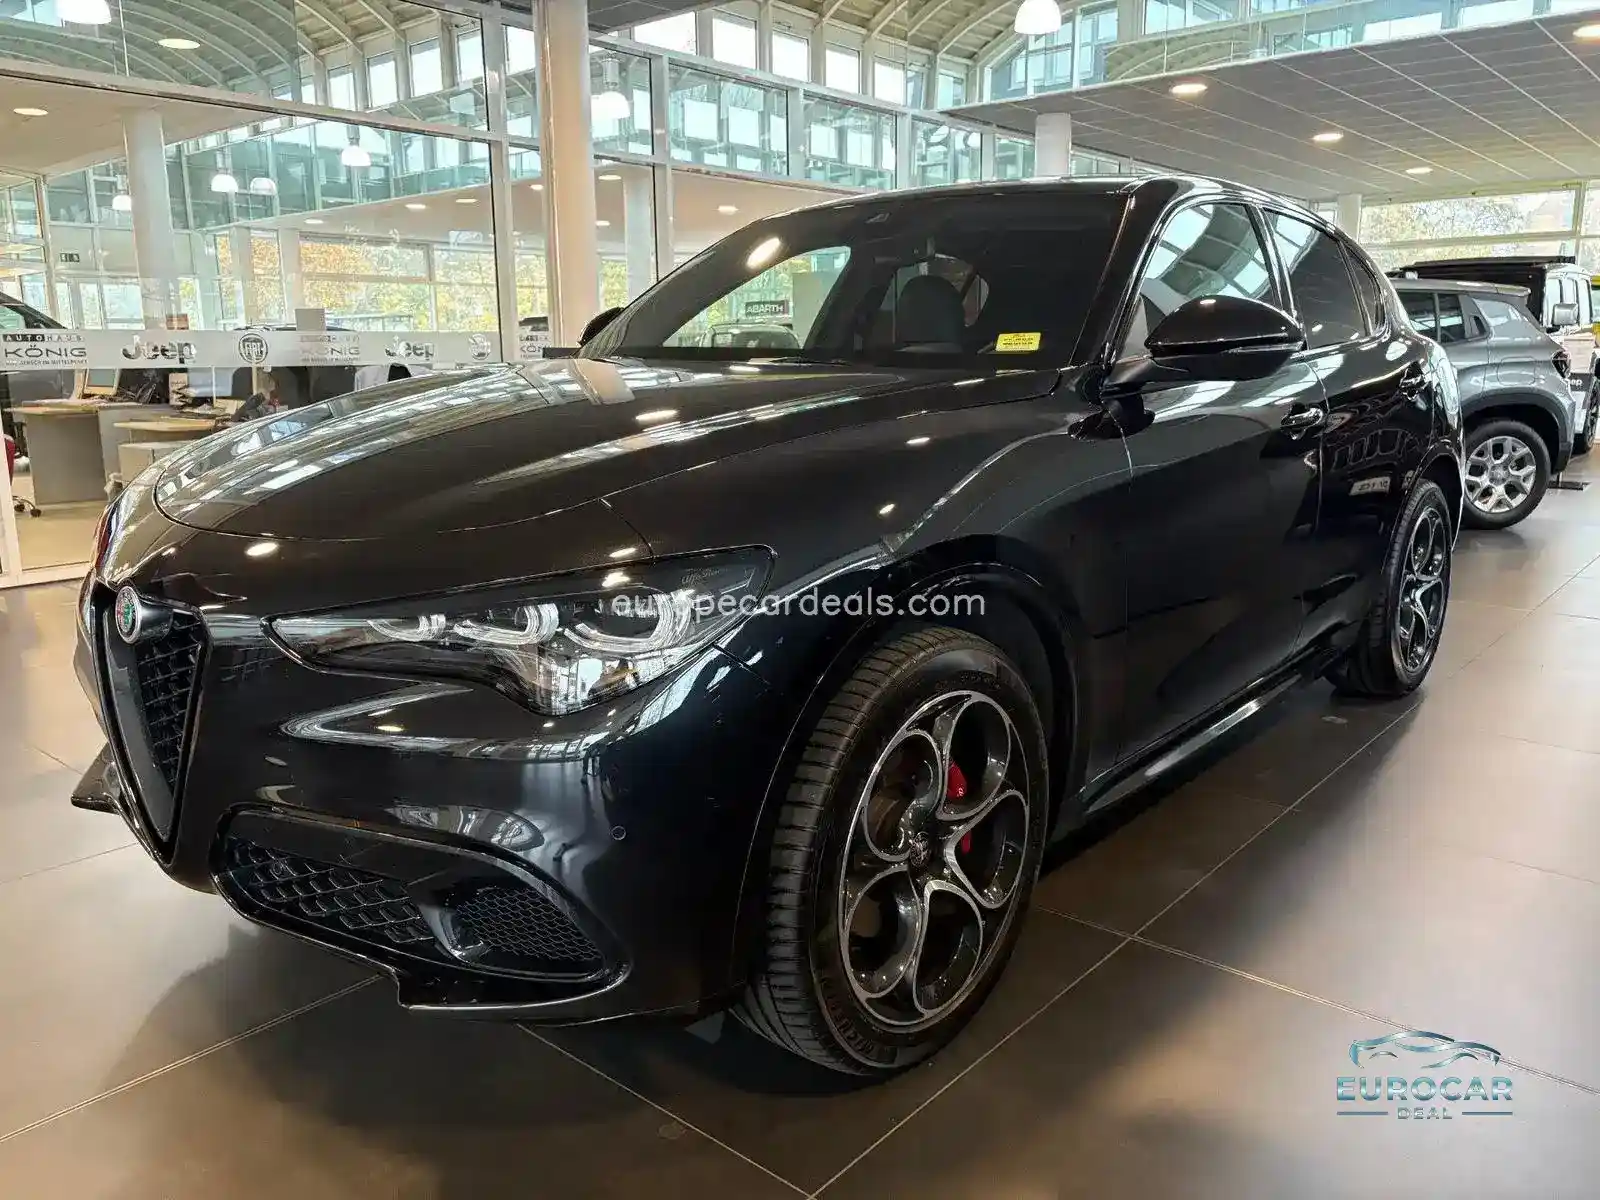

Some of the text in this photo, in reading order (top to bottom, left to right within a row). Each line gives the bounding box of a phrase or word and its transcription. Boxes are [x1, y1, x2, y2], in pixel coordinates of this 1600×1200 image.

[747, 304, 784, 313] ABARTH
[4, 344, 86, 357] KÖNIG
[122, 335, 197, 364] Jeep
